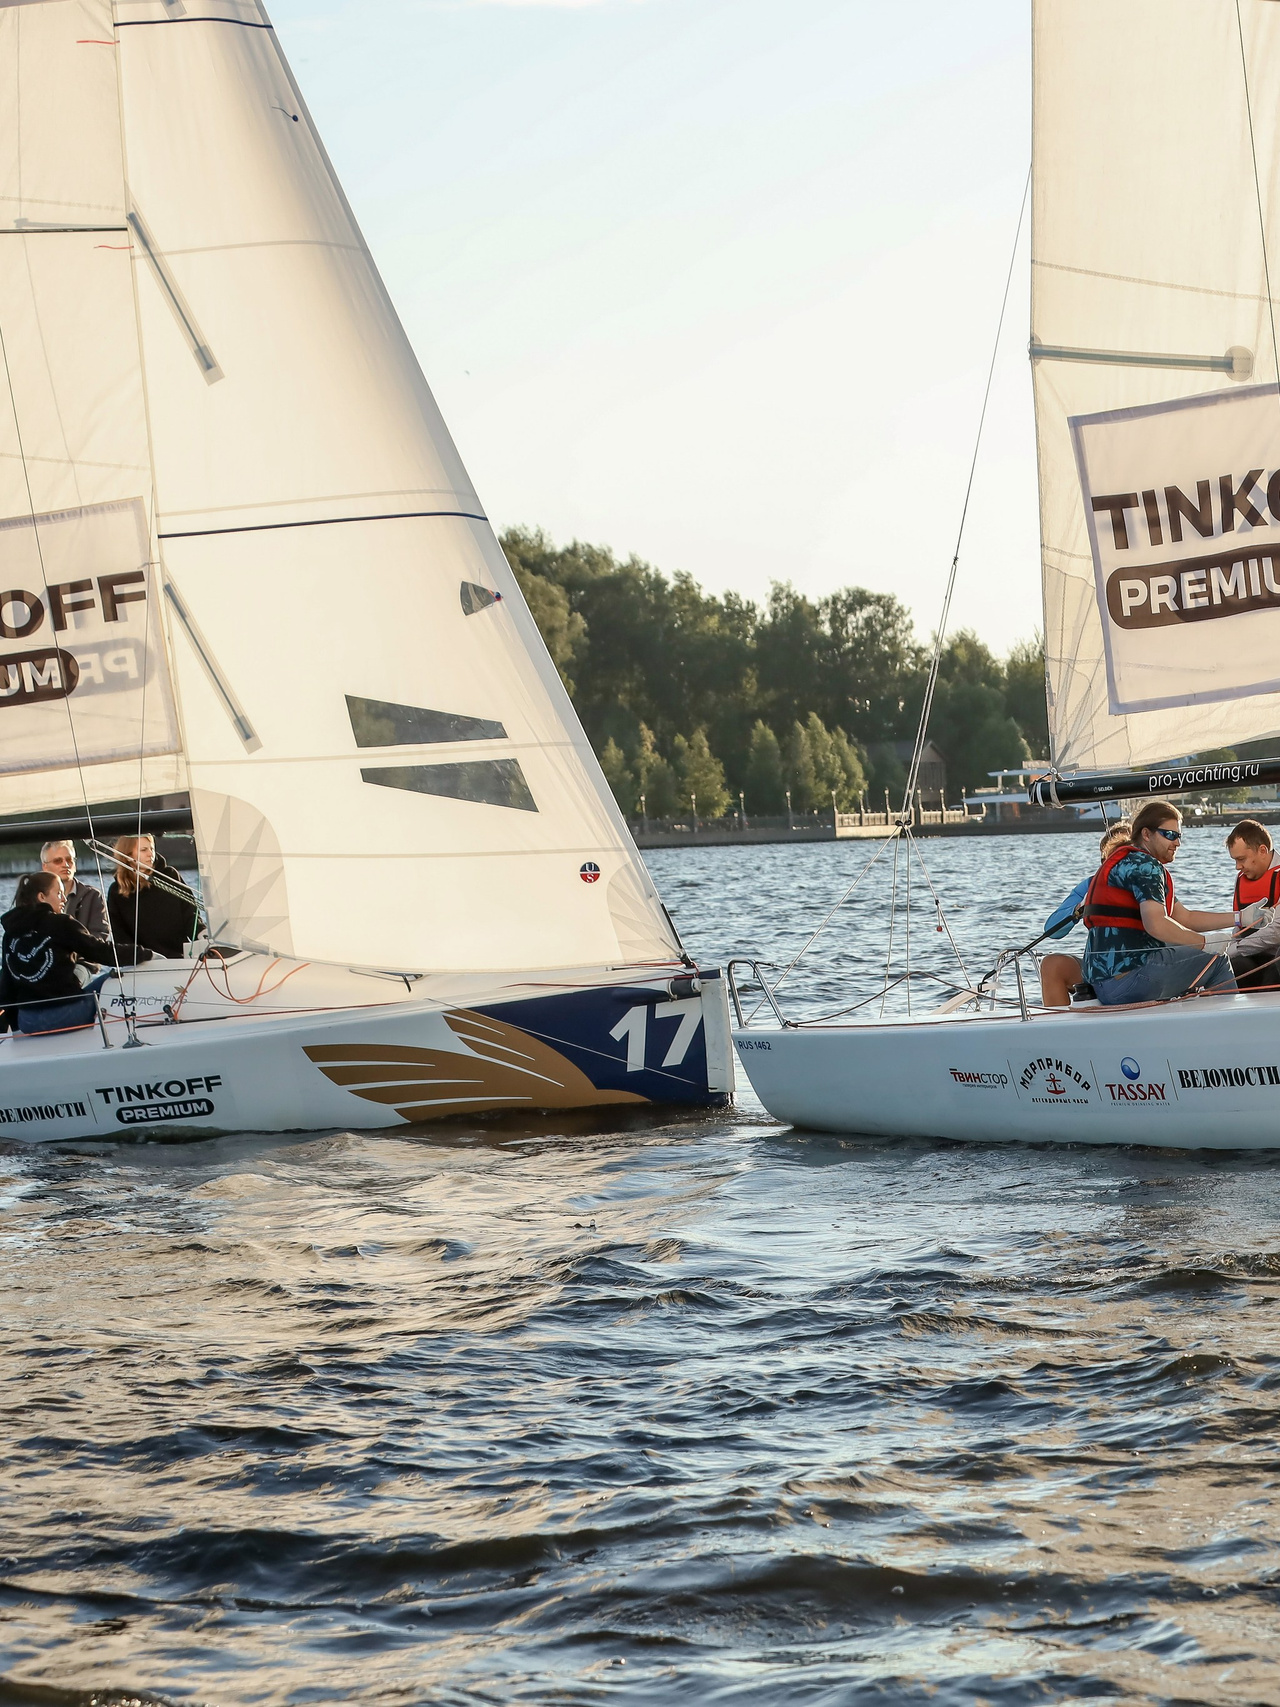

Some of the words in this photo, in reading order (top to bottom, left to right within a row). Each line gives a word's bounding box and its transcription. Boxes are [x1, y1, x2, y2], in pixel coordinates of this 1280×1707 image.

[1148, 763, 1260, 792] pro-yachting.ru
[608, 996, 704, 1073] 17
[737, 1040, 754, 1051] RUS
[754, 1040, 772, 1051] 1462
[1019, 1057, 1091, 1091] МОРПРИБОР
[95, 1075, 223, 1105] TINKOFF
[1105, 1083, 1166, 1101] TASSAY
[122, 1101, 209, 1122] PREMIUM
